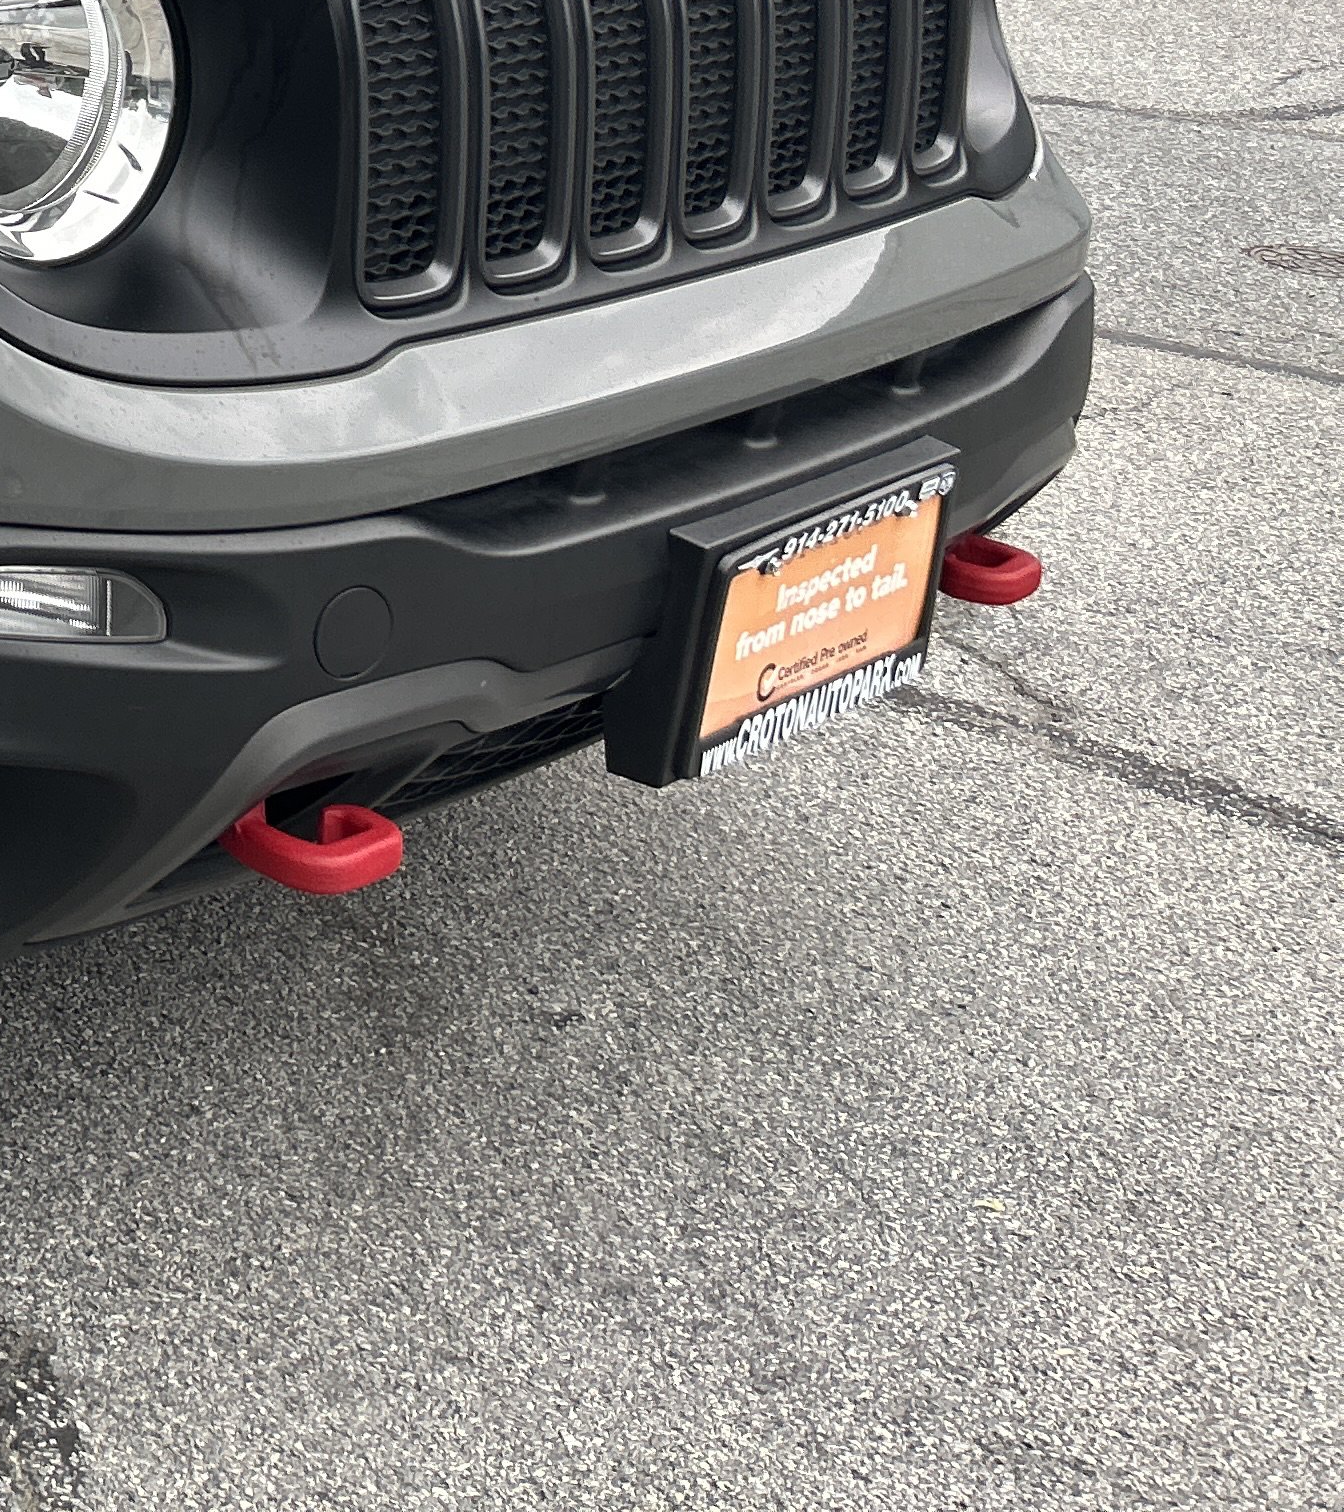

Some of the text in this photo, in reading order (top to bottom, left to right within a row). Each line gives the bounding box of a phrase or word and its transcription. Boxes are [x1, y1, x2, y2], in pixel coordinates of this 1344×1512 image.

[735, 563, 909, 661] from nose to tail.
[775, 544, 878, 612] Inspected
[778, 651, 819, 681] Certified
[820, 647, 836, 662] Pre
[838, 629, 868, 654] owned
